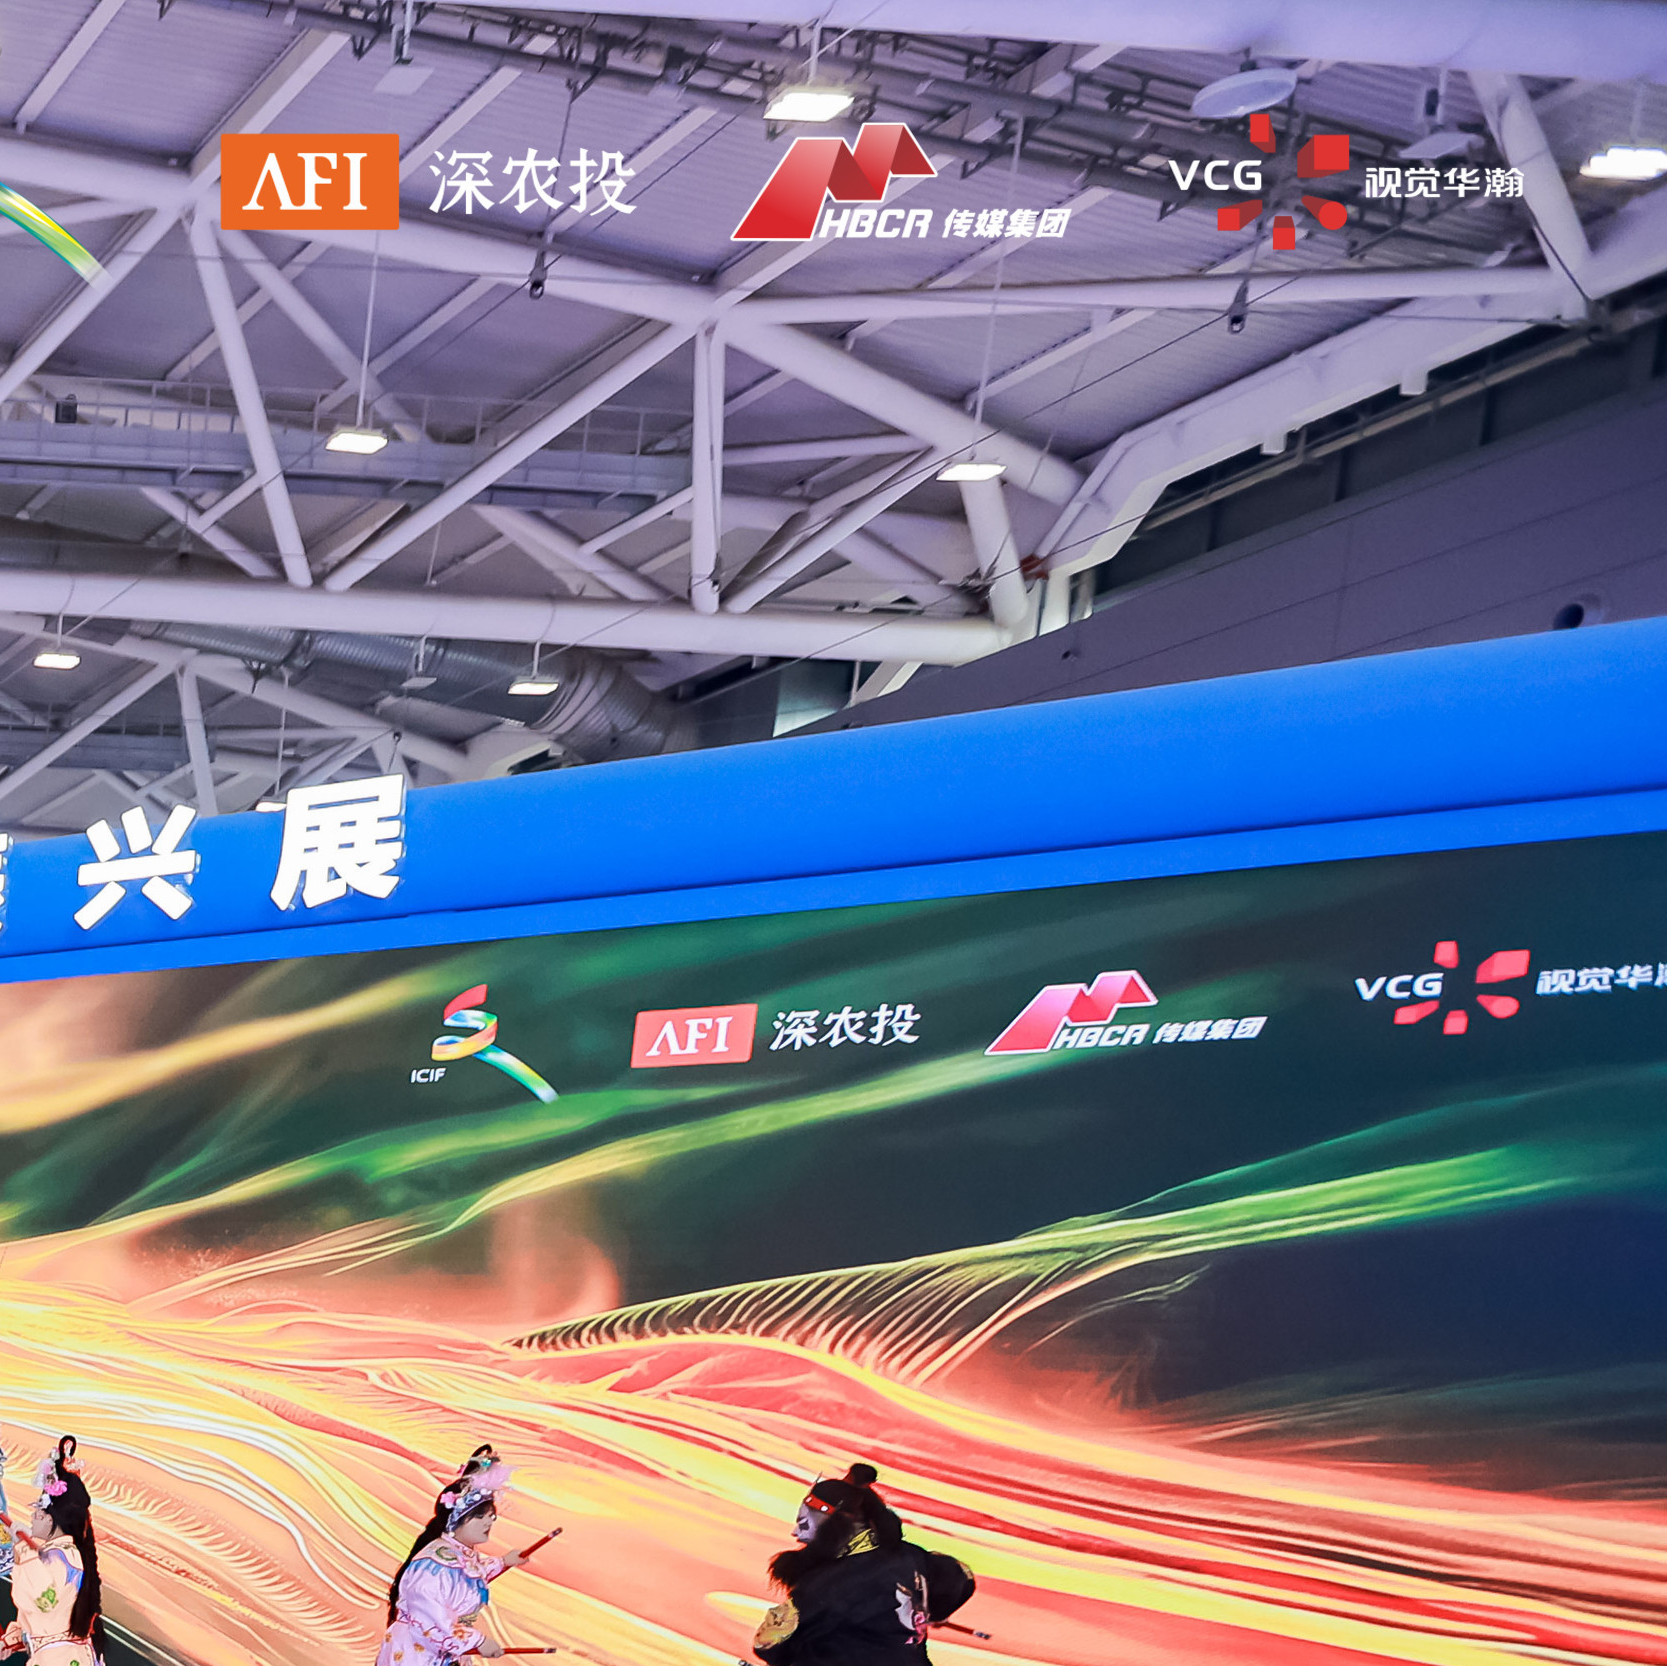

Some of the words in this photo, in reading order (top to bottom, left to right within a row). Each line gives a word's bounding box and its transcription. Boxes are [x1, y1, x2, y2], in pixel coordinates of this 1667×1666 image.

[1355, 971, 1445, 1001] VCG
[768, 1003, 922, 1053] 深农投
[1152, 1015, 1269, 1046] 传媒集团
[409, 1067, 447, 1085] ICIF
